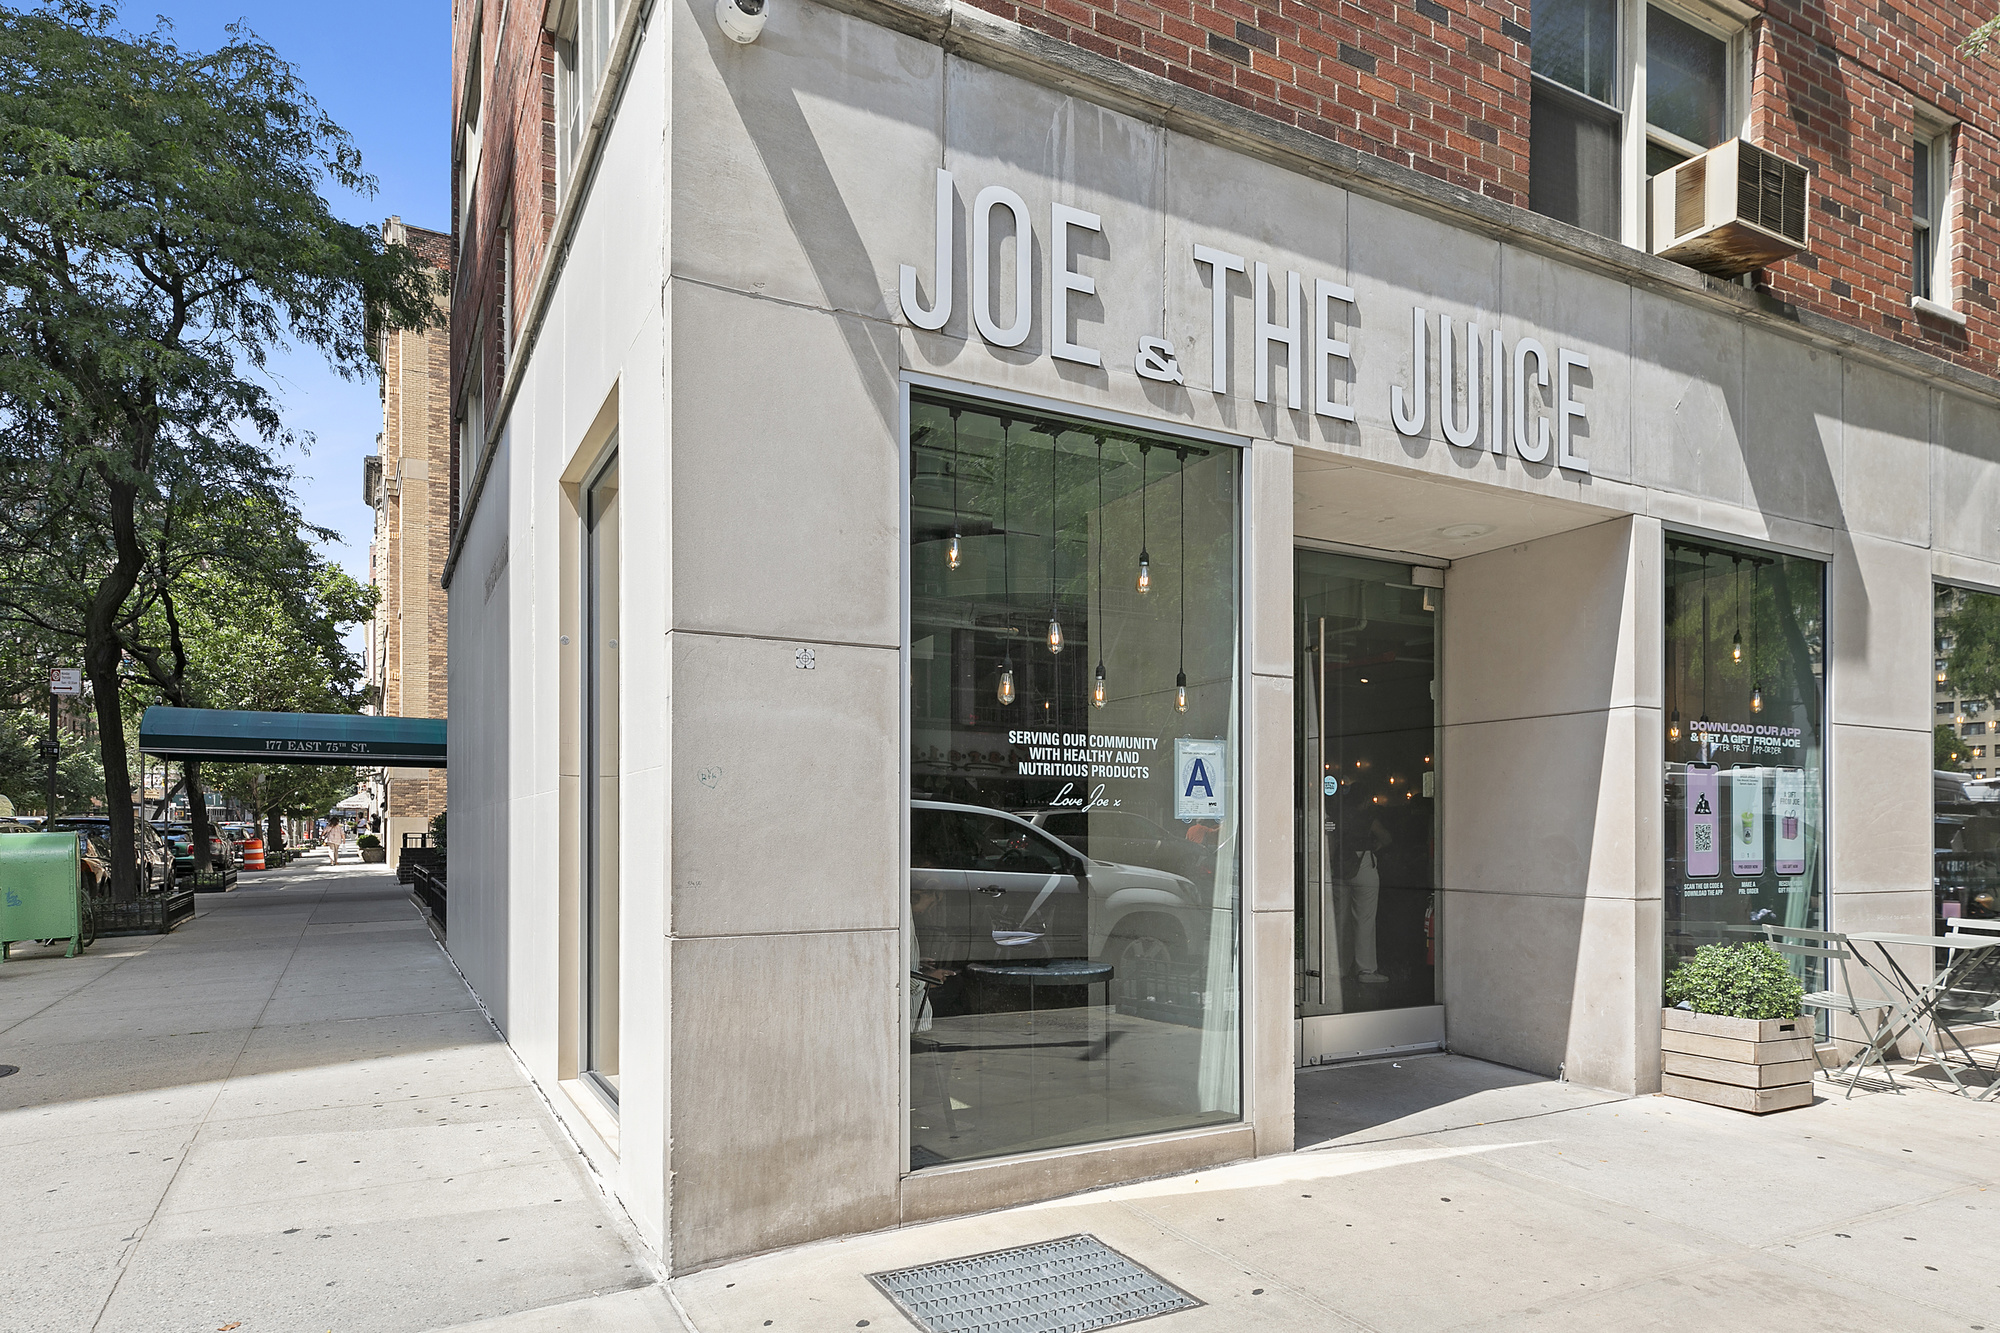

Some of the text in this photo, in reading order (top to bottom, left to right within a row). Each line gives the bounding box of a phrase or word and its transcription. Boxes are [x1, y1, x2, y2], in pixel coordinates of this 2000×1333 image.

[899, 168, 1590, 473] JOE & THE JUICE
[1689, 720, 1801, 738] DOWNLOAD OUR APP
[265, 740, 370, 753] 177 EAST 75TH ST.
[1008, 730, 1158, 750] SERVING OUR COMMUNITY
[1690, 732, 1801, 748] & GET A GIFT FROM JOE
[1029, 747, 1140, 764] WITH HEALTHY AND
[1018, 762, 1150, 779] NUTRITIOUS PRODUCTS
[1185, 758, 1214, 797] A
[1049, 782, 1122, 813] Love Joe x
[1684, 889, 1707, 897] DOWNLOAD
